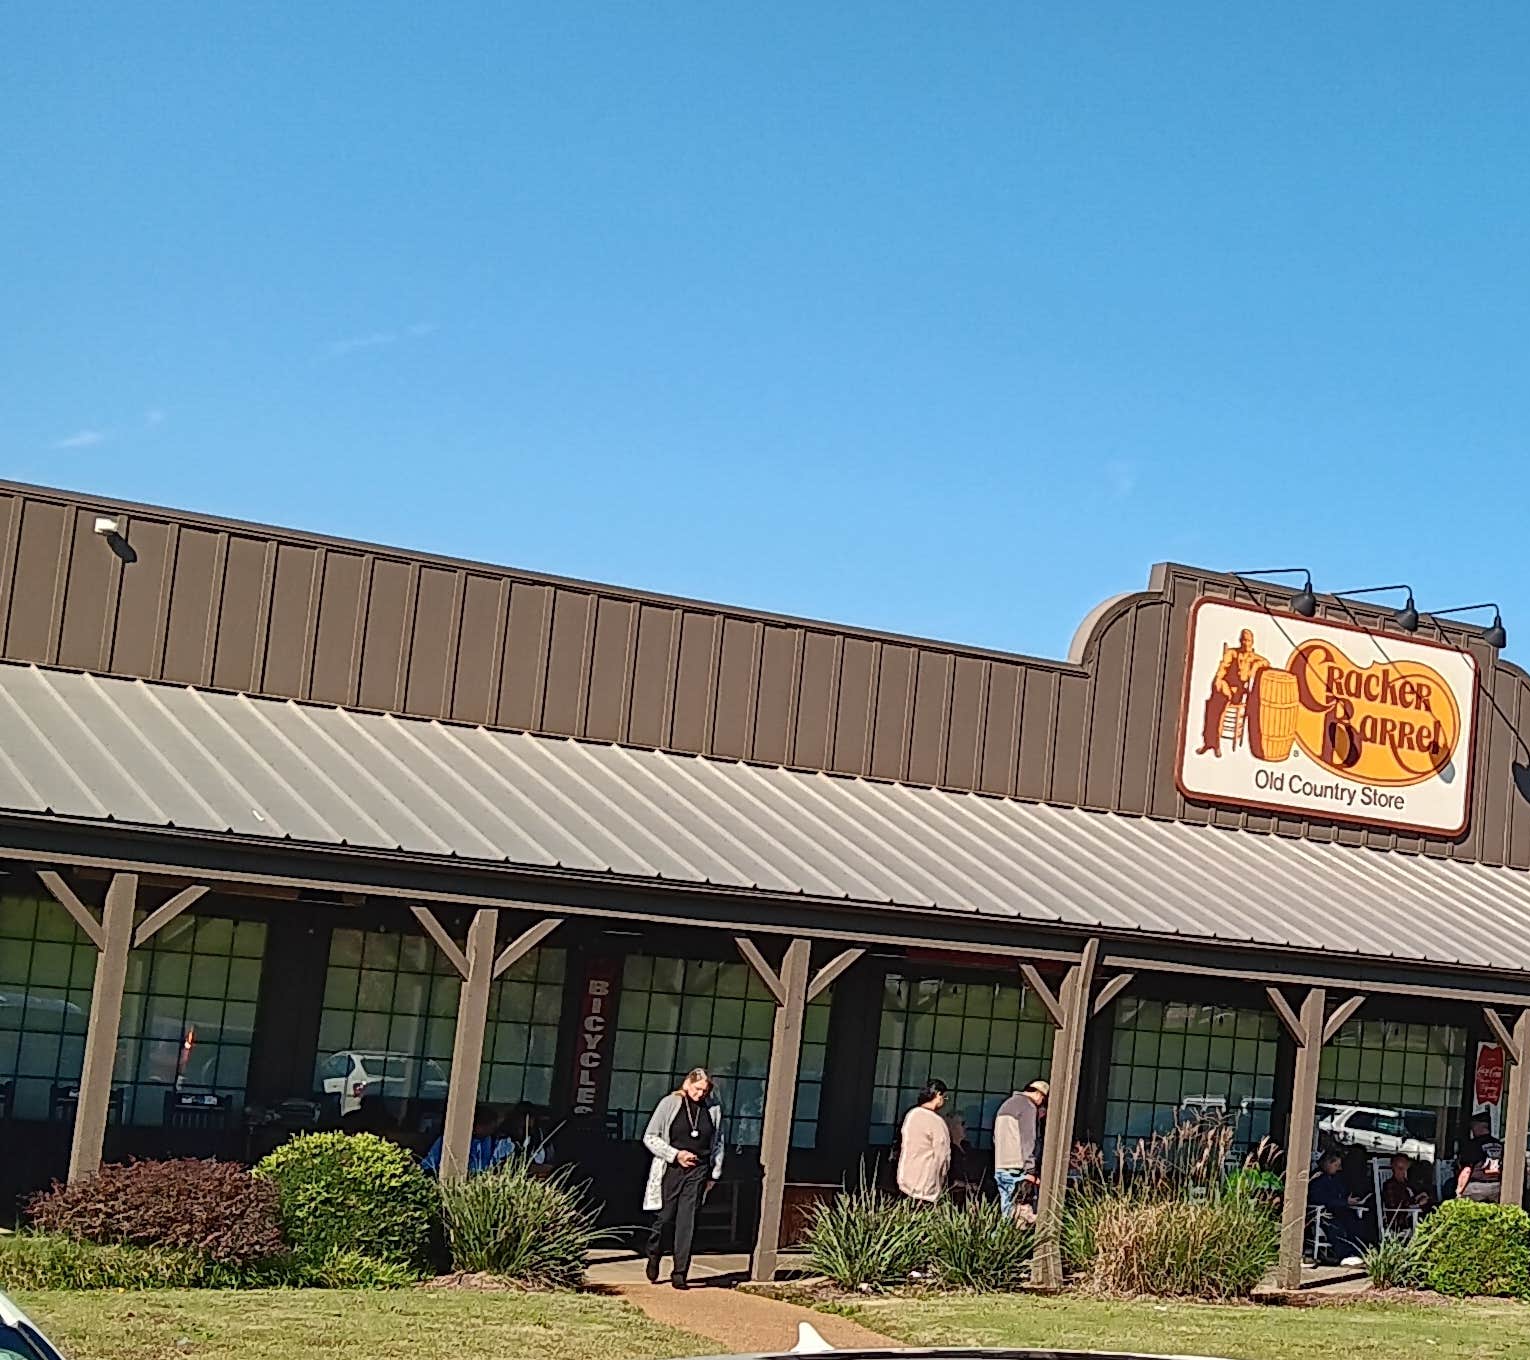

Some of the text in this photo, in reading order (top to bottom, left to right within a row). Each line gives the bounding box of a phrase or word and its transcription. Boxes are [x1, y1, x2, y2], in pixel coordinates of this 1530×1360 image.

[1290, 644, 1434, 713] Cracker
[1320, 696, 1442, 773] Barrel
[1255, 769, 1405, 810] Old Country Store
